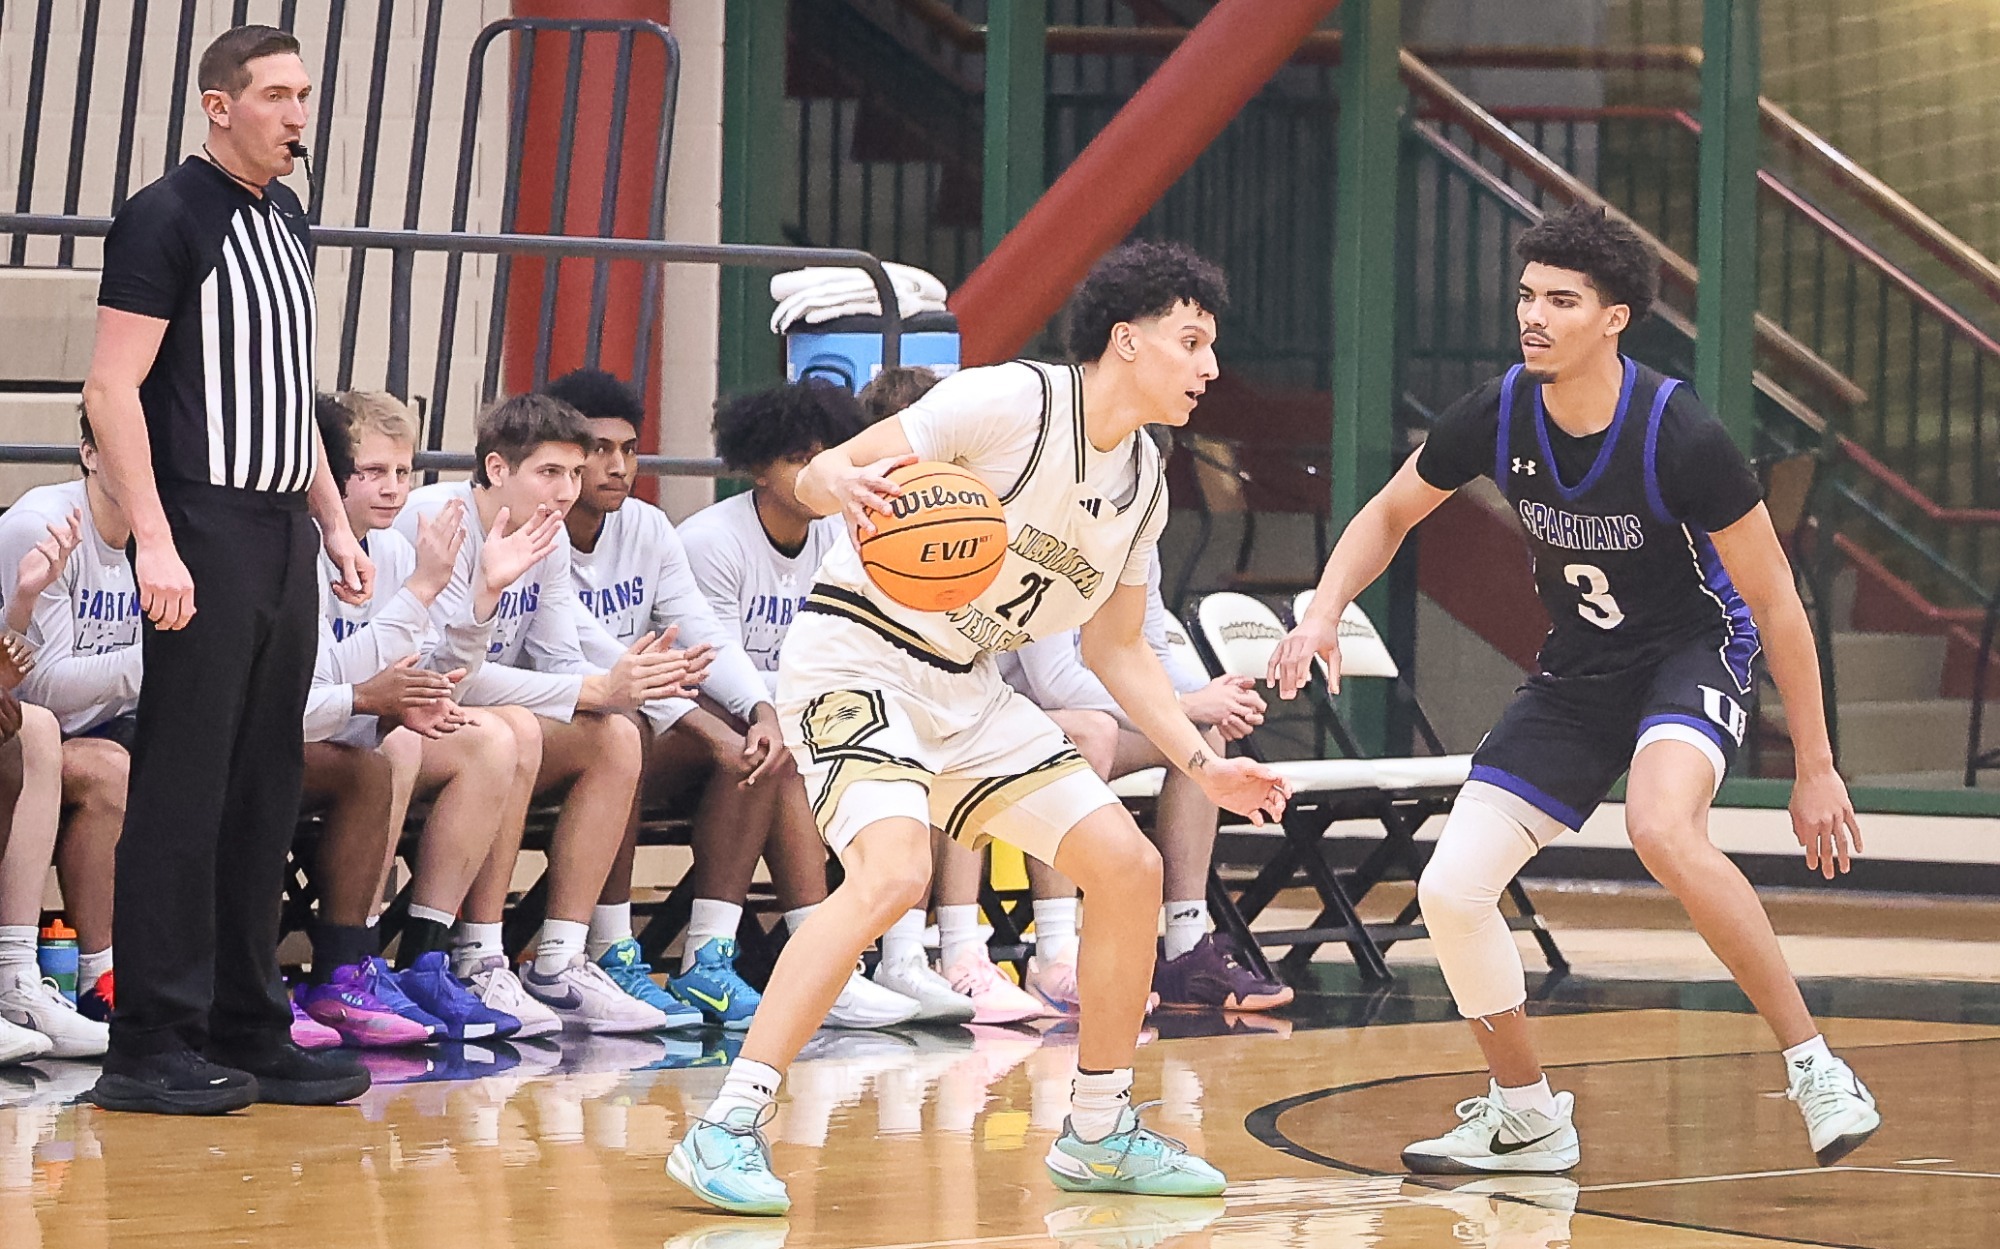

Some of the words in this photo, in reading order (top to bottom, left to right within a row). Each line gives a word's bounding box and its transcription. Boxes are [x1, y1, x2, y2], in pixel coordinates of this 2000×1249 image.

[889, 485, 989, 519] Wilson
[1519, 499, 1643, 550] SPARTANS
[920, 537, 979, 562] EVO
[1563, 564, 1625, 630] 3
